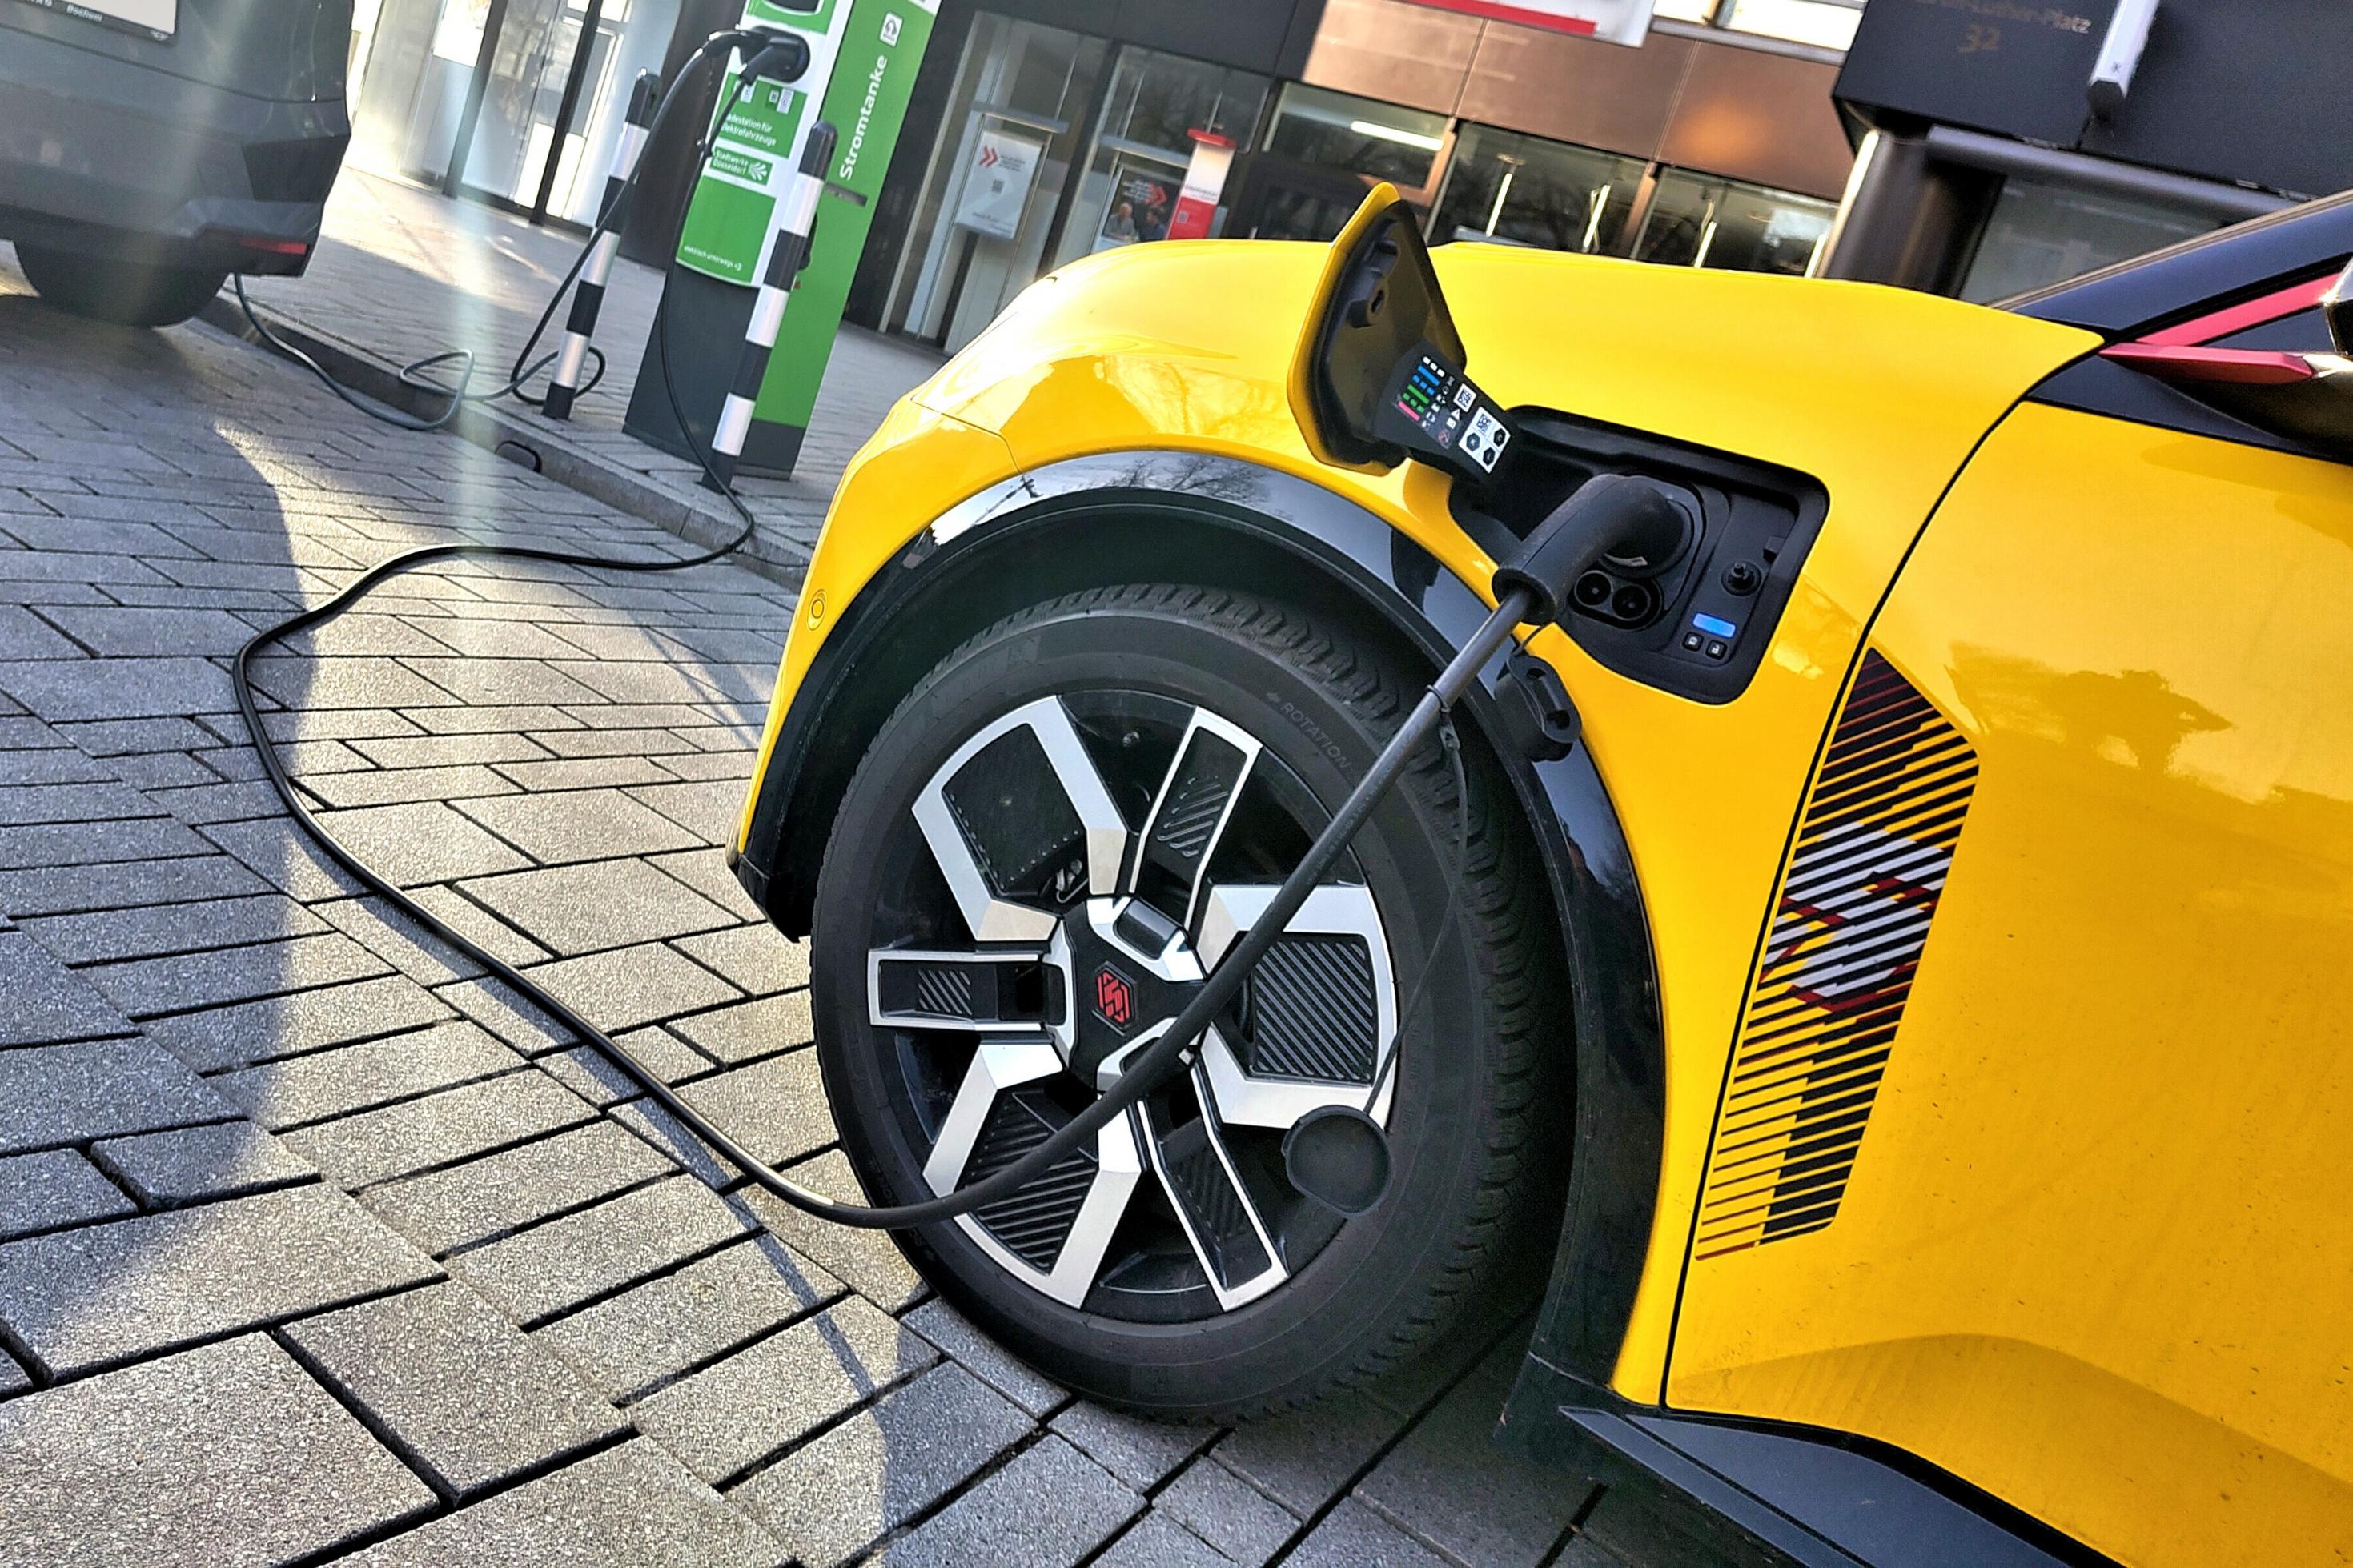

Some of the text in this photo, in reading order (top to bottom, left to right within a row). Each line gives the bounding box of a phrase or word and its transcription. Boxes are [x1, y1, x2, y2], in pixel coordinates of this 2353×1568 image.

[1958, 24, 2002, 54] 32
[725, 114, 773, 134] adestation für
[839, 54, 888, 181] Stromtanke
[1281, 701, 1353, 770] ROTATION
